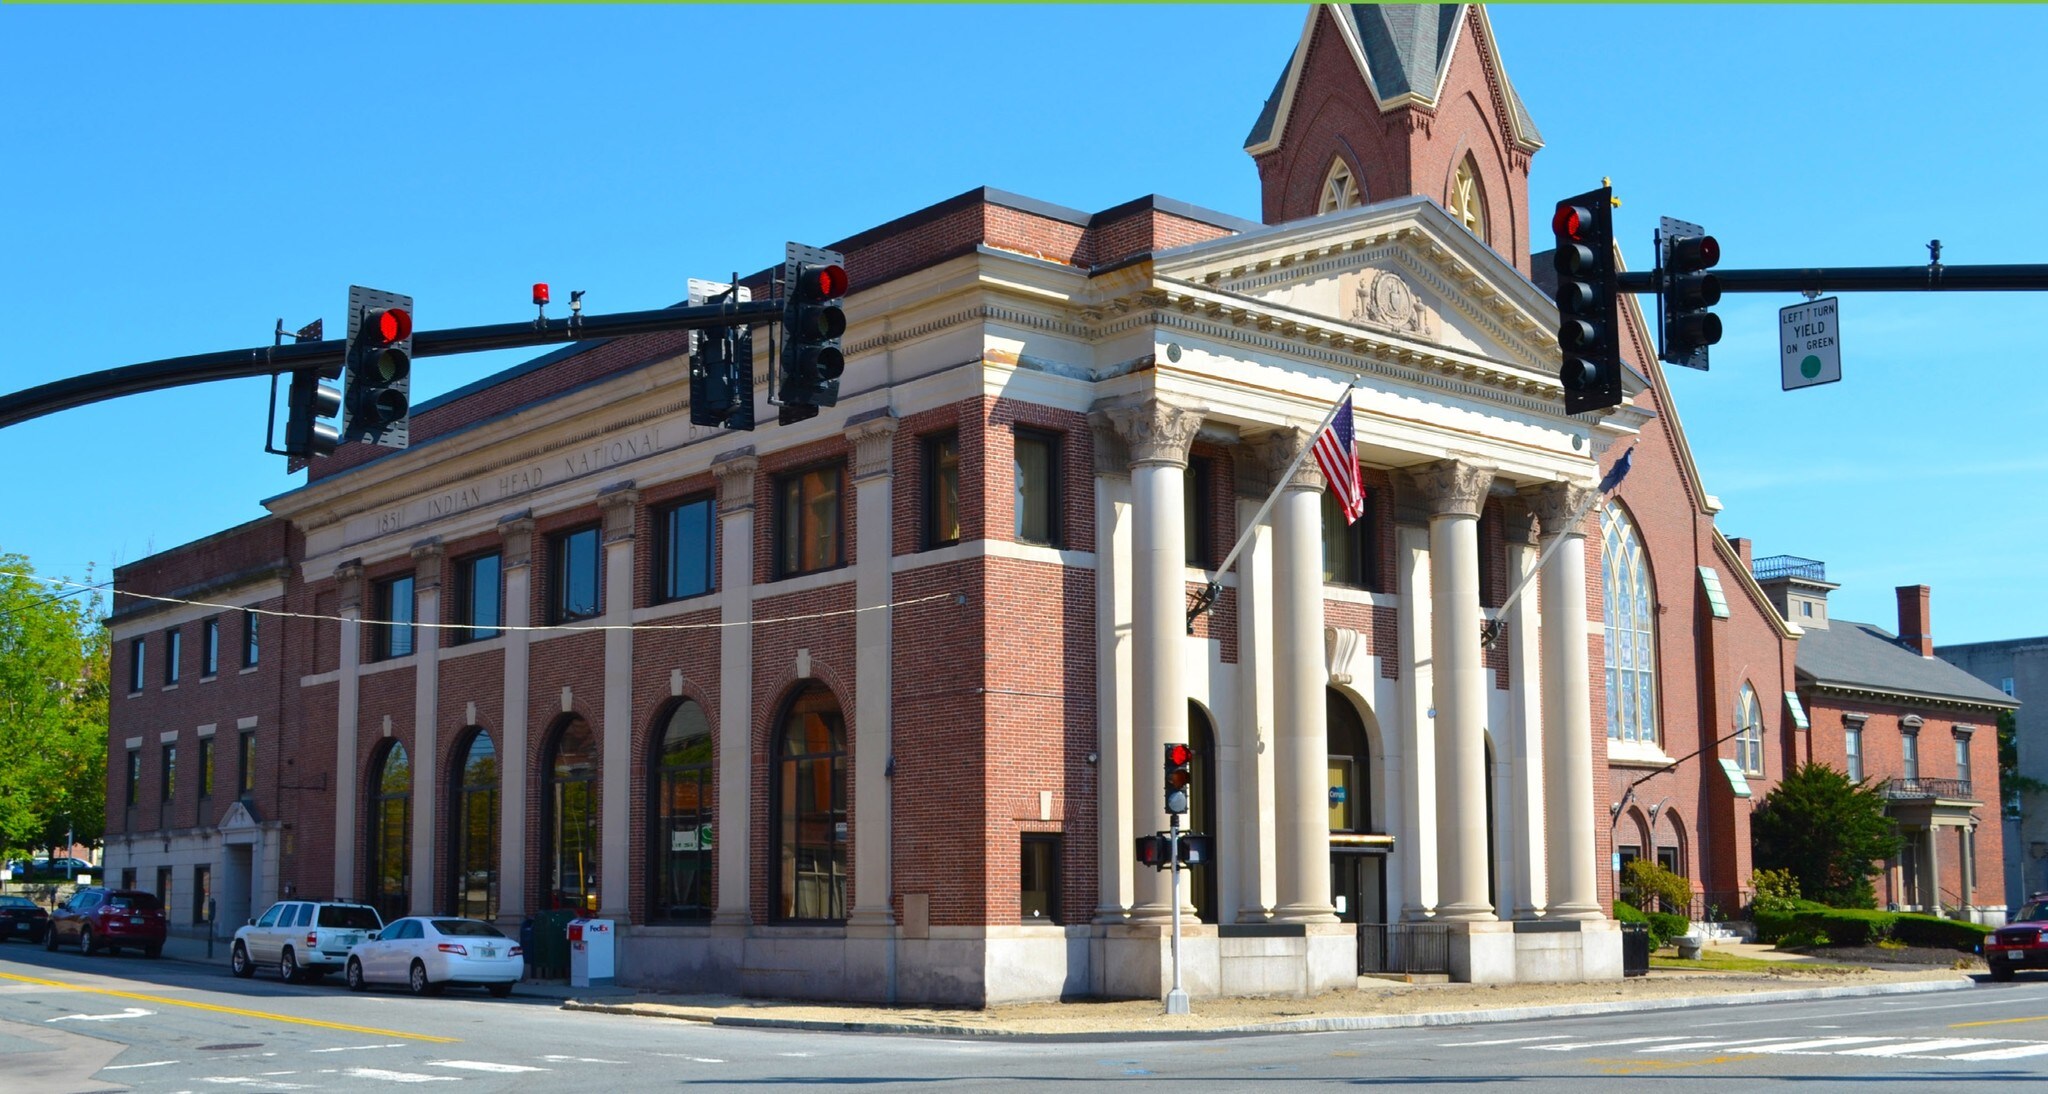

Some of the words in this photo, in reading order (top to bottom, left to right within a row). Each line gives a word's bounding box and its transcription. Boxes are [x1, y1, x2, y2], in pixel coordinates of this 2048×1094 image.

[1783, 310, 1804, 324] LEFT
[1813, 304, 1835, 317] TURN
[1794, 321, 1825, 338] YIELD
[1786, 343, 1798, 354] ON
[1806, 337, 1834, 350] GREEN
[377, 511, 401, 534] 1851
[427, 486, 480, 520] INDIAN
[499, 467, 543, 497] HEAD
[565, 429, 664, 476] NATIONAL
[590, 924, 609, 932] FedEx
